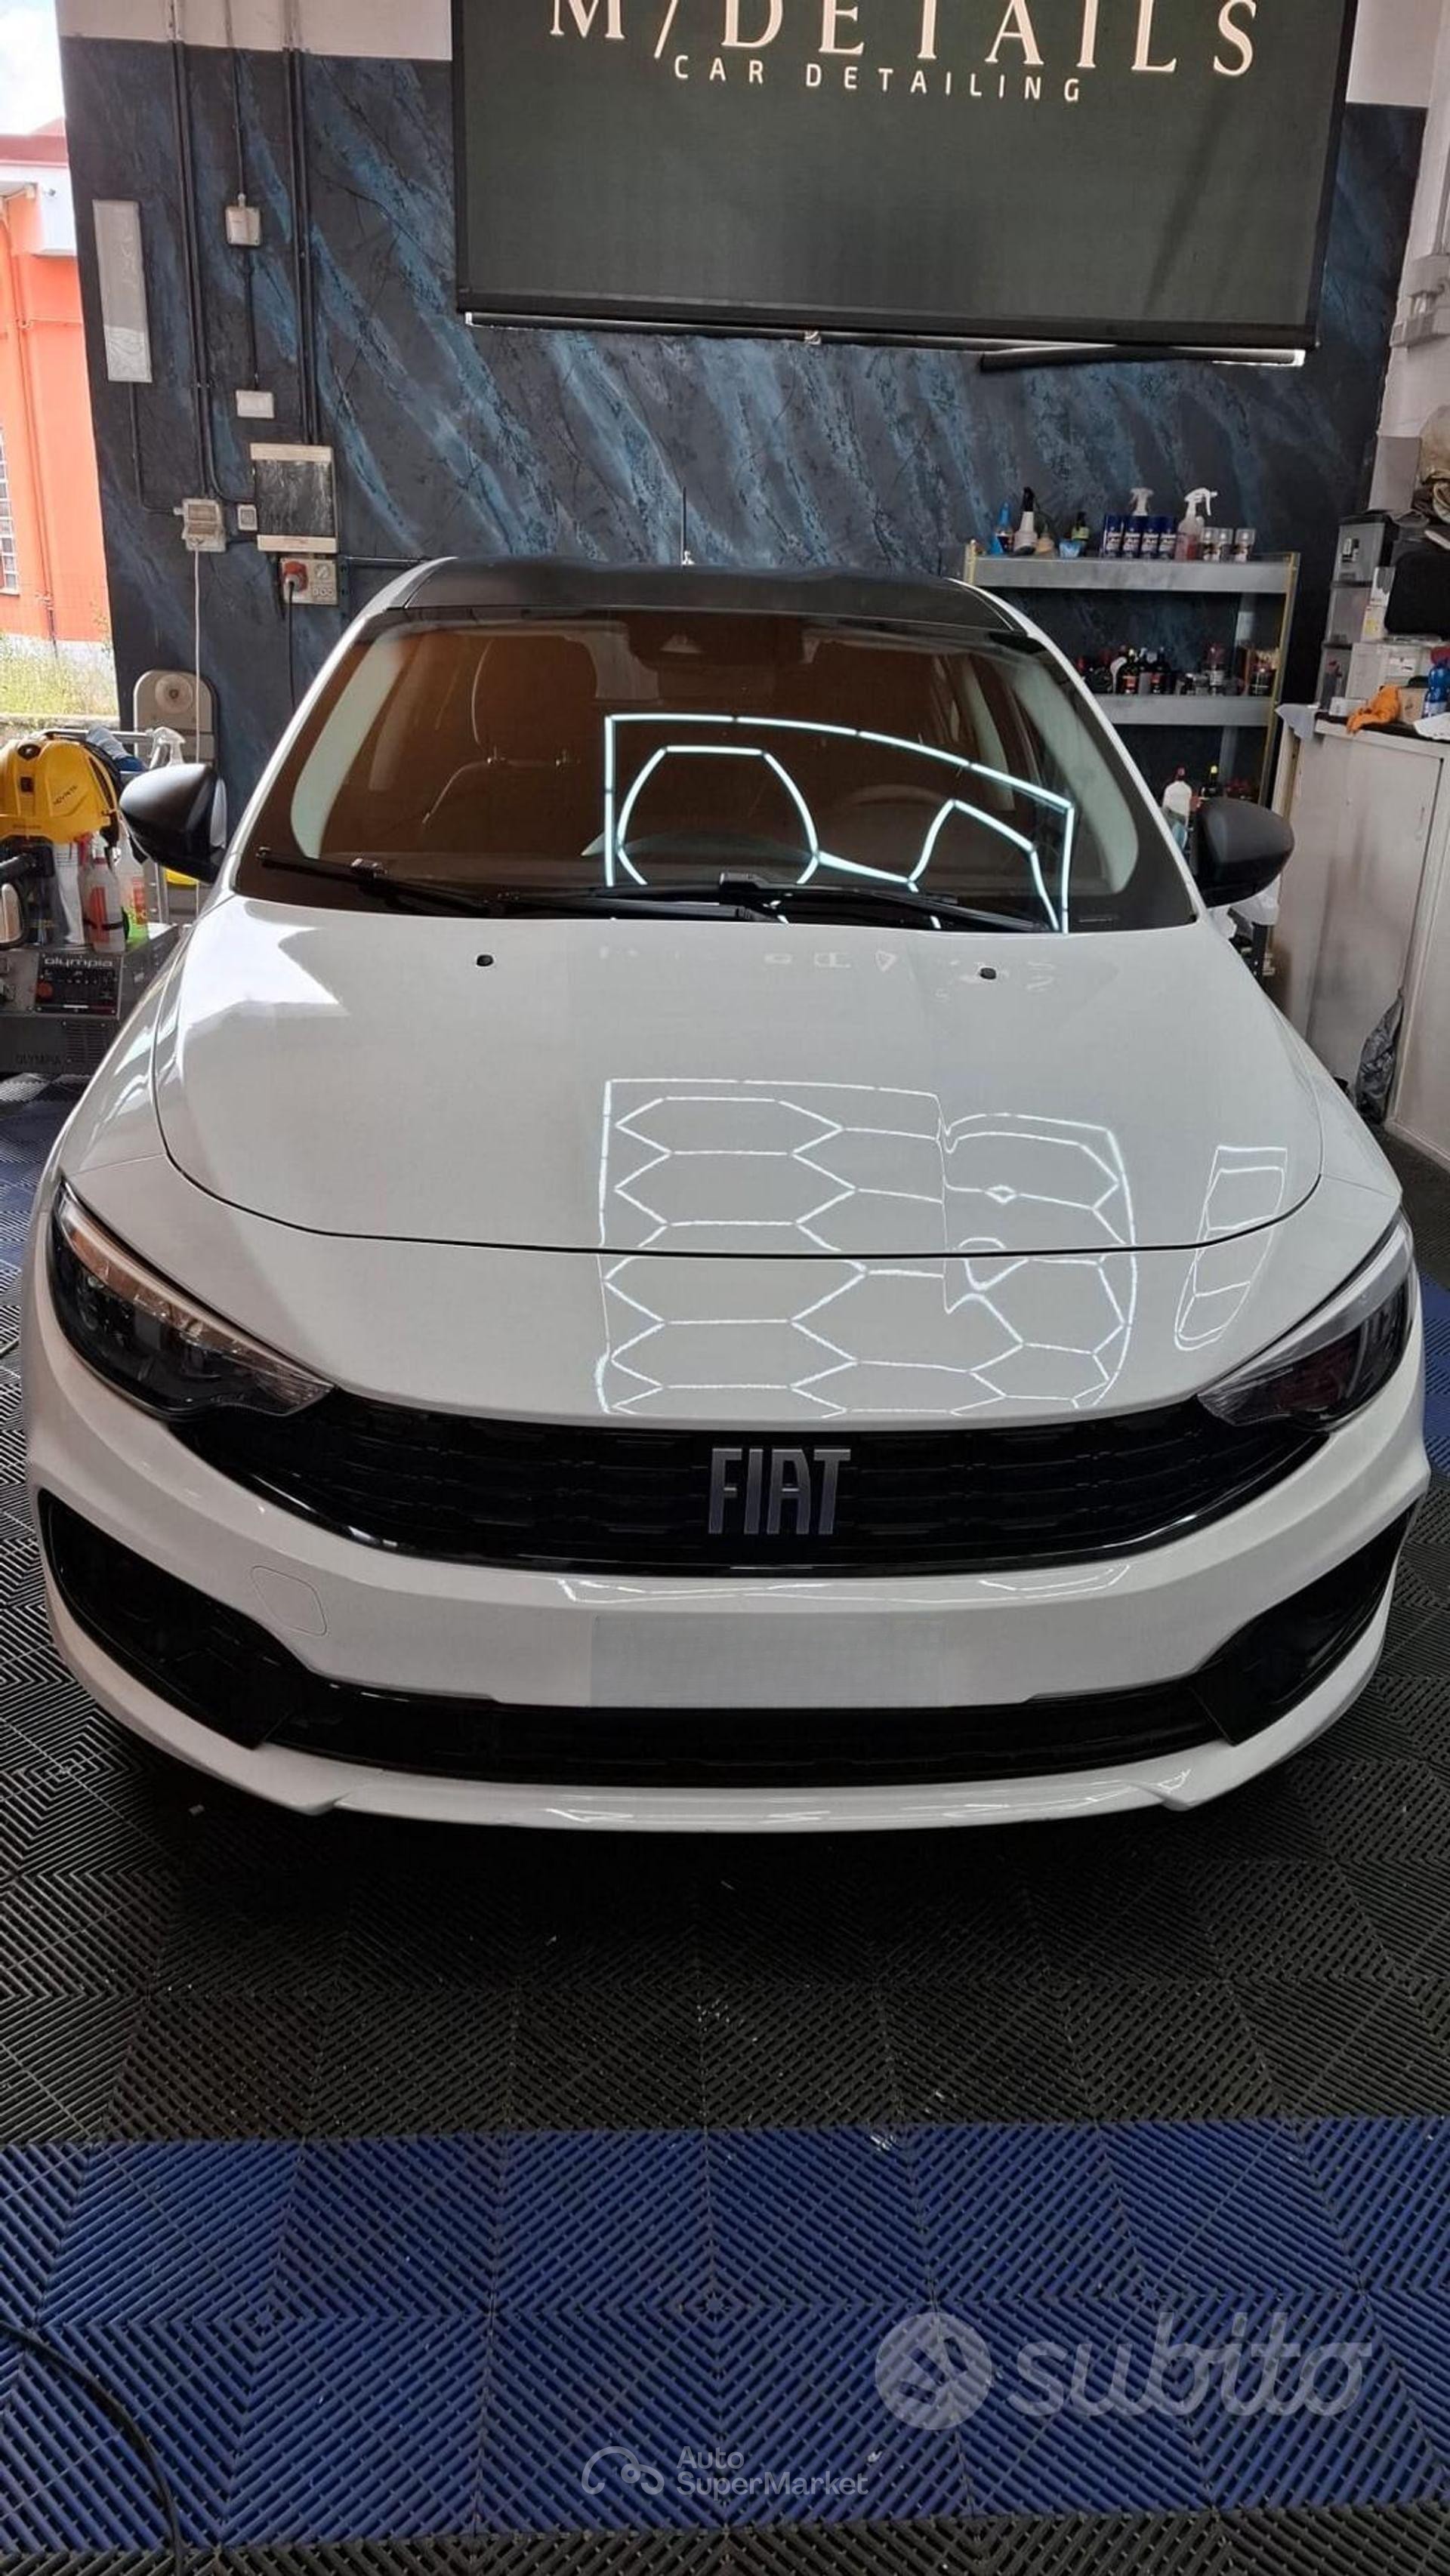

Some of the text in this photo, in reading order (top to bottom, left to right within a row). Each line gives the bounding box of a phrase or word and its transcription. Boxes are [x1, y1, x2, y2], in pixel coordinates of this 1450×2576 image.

[674, 55, 1080, 103] CAR DETAILING
[44, 957, 113, 969] olympia
[708, 1447, 852, 1535] FIAT
